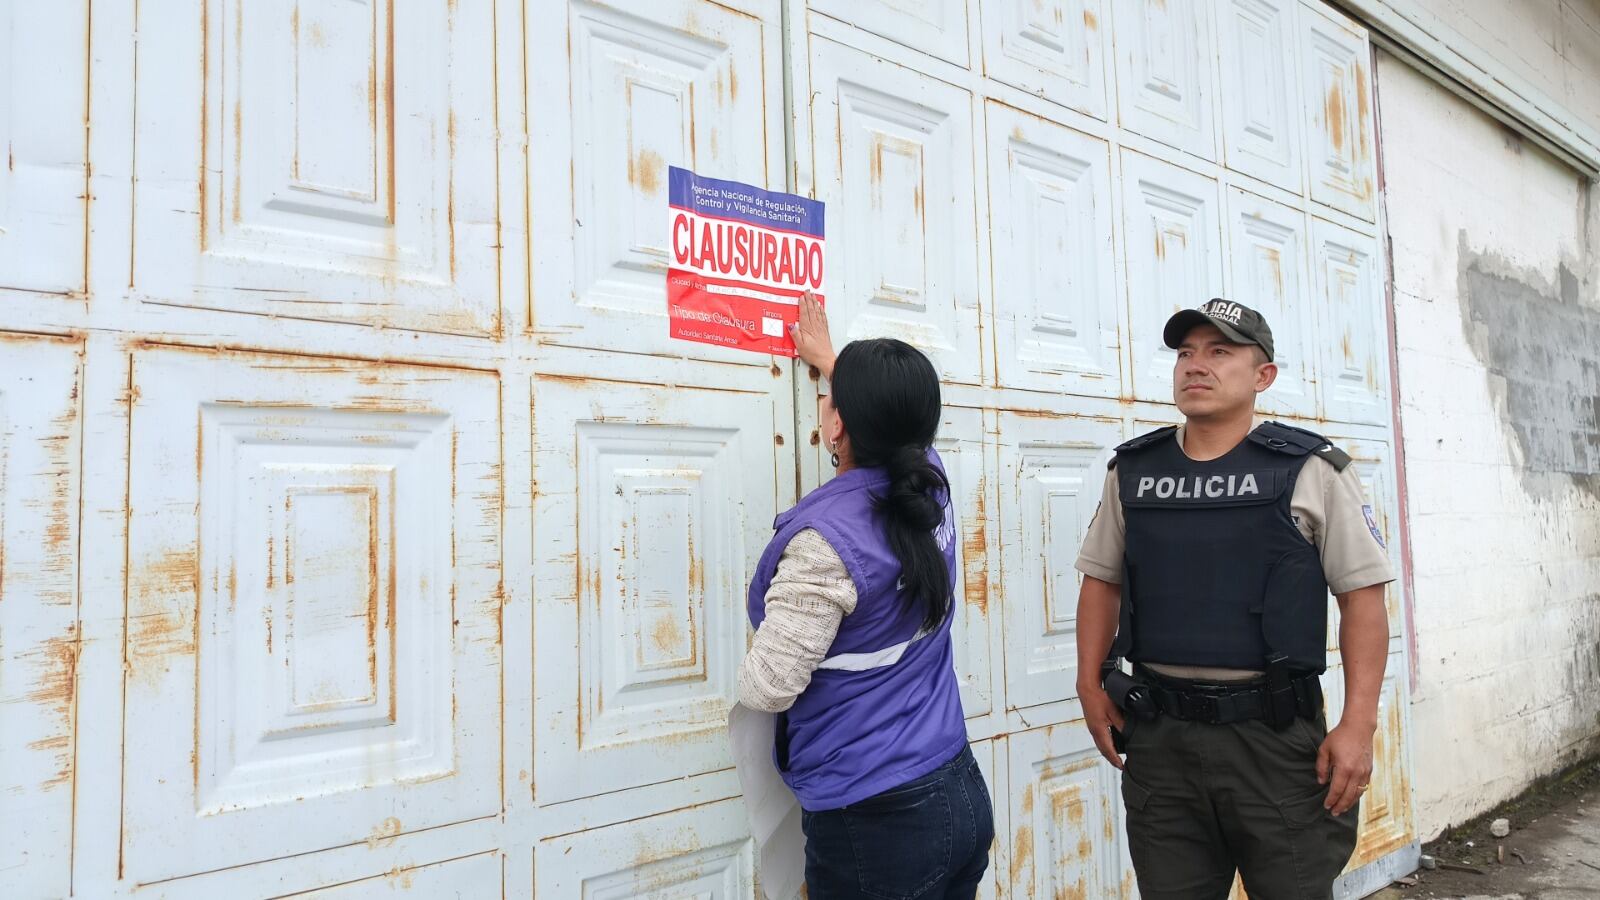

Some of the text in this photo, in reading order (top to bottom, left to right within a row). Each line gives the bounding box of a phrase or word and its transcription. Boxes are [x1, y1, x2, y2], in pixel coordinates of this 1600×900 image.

[695, 195, 801, 224] Control y Vigilancia Sanitaria
[721, 189, 754, 204] Nacional
[755, 197, 764, 206] de
[673, 213, 823, 290] CLAUSURADO
[672, 303, 696, 321] Tipo
[712, 311, 755, 331] Clausura
[1198, 301, 1242, 320] OLICÍA
[1136, 473, 1259, 499] POLICIA
